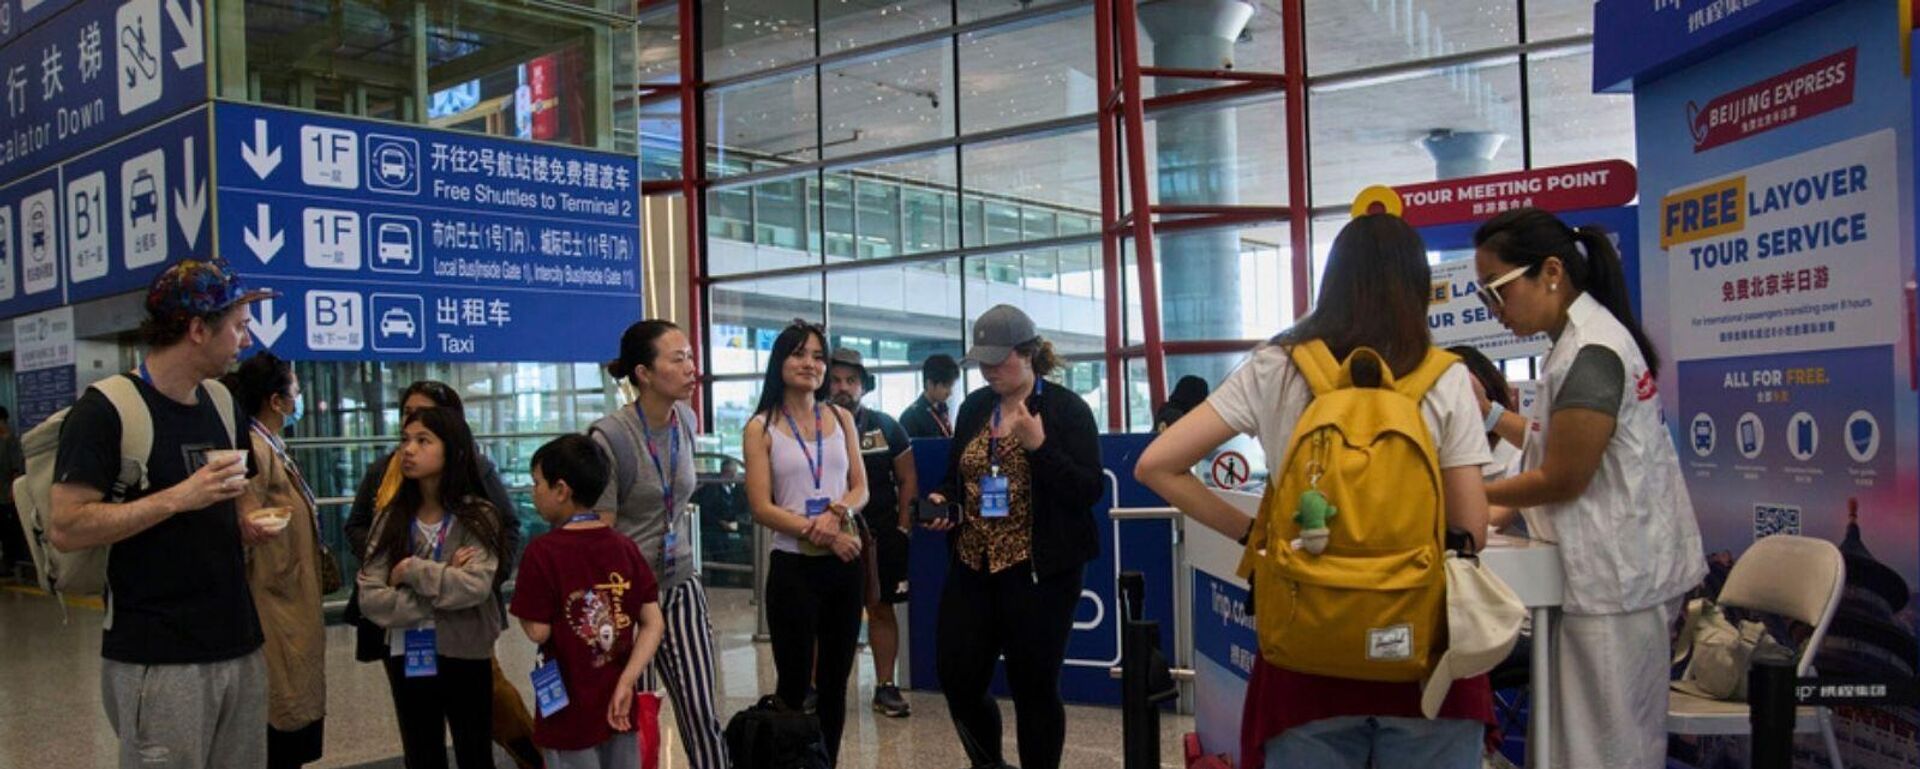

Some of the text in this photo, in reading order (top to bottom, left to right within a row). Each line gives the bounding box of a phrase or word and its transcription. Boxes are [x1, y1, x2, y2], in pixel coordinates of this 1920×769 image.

[7, 20, 103, 118] 行扶梯
[1709, 62, 1847, 127] BEIJING EXPRESS
[57, 98, 104, 140] Down
[312, 134, 351, 163] 1F
[431, 143, 631, 192] 开往2号航站楼免费摆渡车
[433, 180, 631, 216] Free Shuttles to Terminal 2
[1402, 170, 1611, 208] TOUR MEETING POINT
[1665, 165, 1868, 237] FREE LAYOVER
[75, 185, 102, 240] B1
[313, 215, 353, 245] 1F
[1690, 213, 1868, 271] TOUR SERVICE
[433, 257, 458, 277] Local
[502, 261, 521, 280] Gate
[604, 267, 622, 285] Gate
[1722, 266, 1830, 302] 免费北京半日游
[315, 296, 353, 326] B1
[437, 297, 511, 327] 出租车
[1821, 301, 1839, 312] over
[1848, 298, 1873, 309] hours
[438, 333, 475, 353] Taxi
[1723, 367, 1831, 388] ALL FOR FREE.
